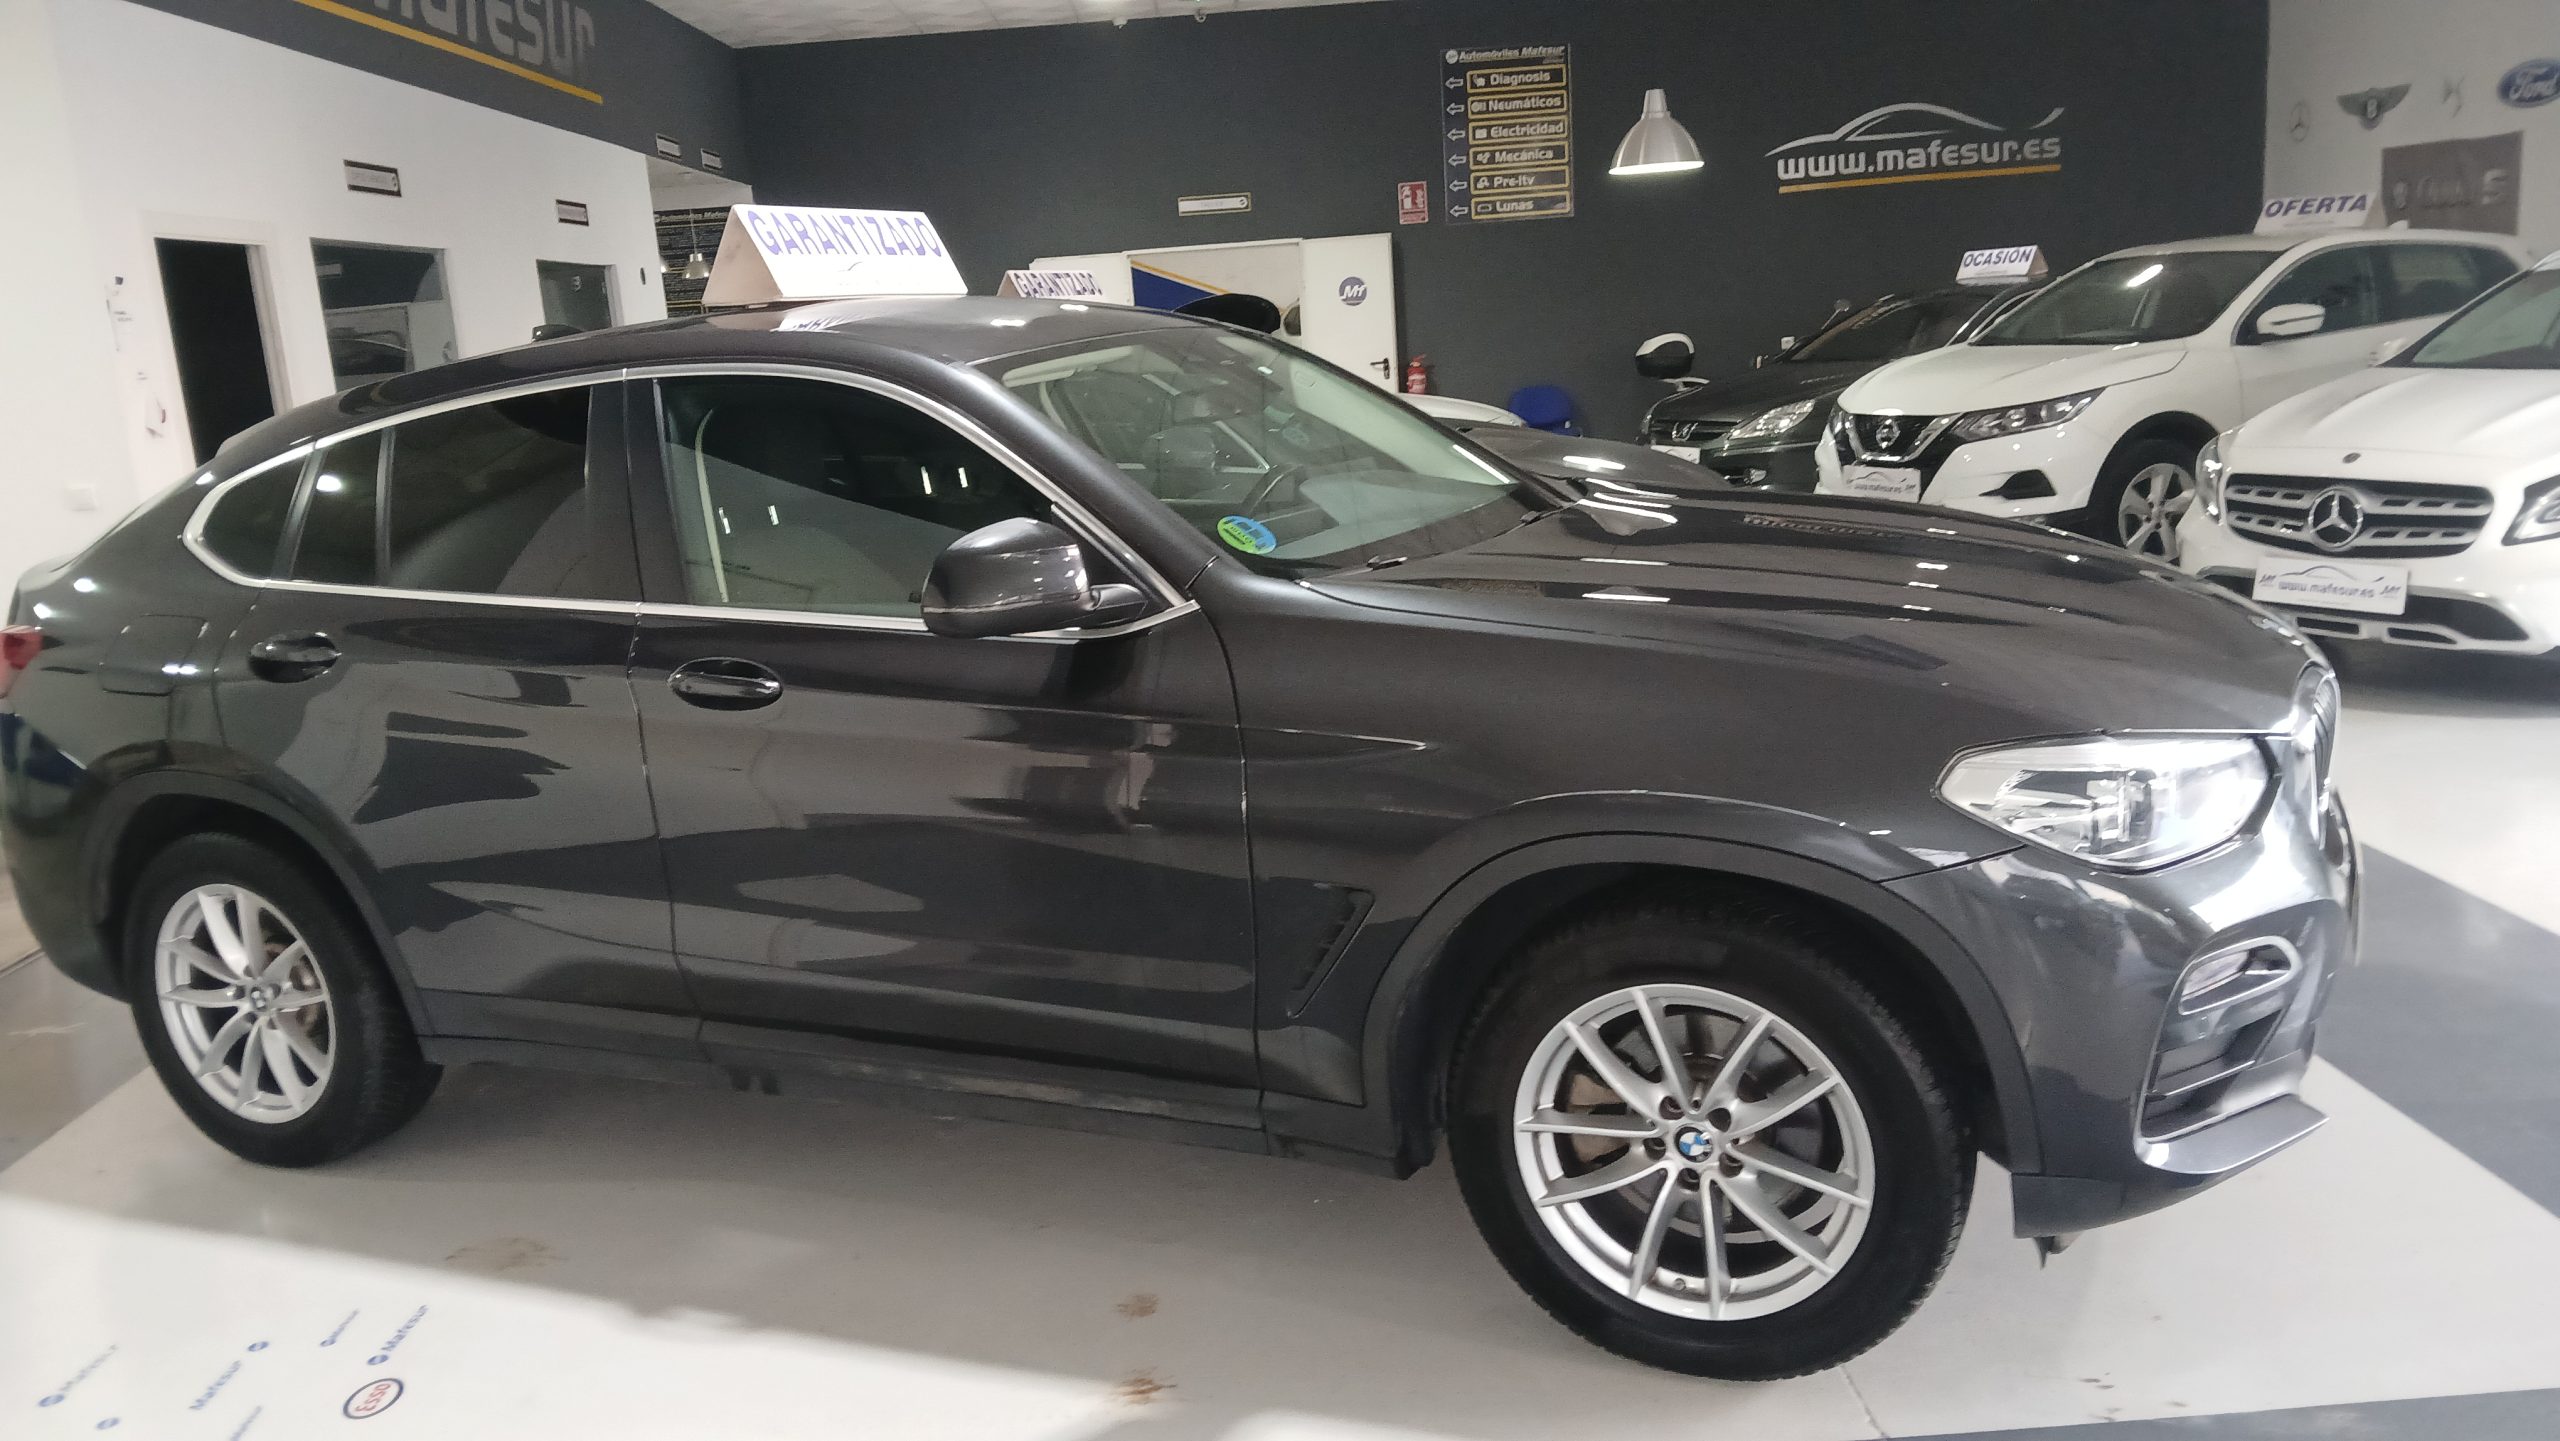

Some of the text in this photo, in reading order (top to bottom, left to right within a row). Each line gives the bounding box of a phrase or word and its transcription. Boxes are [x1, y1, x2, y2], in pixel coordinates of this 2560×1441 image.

[374, 0, 597, 80] esur
[1490, 71, 1551, 86] Diagnosis
[1488, 96, 1561, 111] Neumáticos
[1490, 122, 1564, 138] Electricidad
[1777, 138, 2061, 181] www.mafesur.es
[1496, 200, 1534, 212] Lunas
[2265, 195, 2367, 217] OFERTA
[748, 210, 942, 257] GARANTIZADO
[1963, 248, 2033, 268] OCASION
